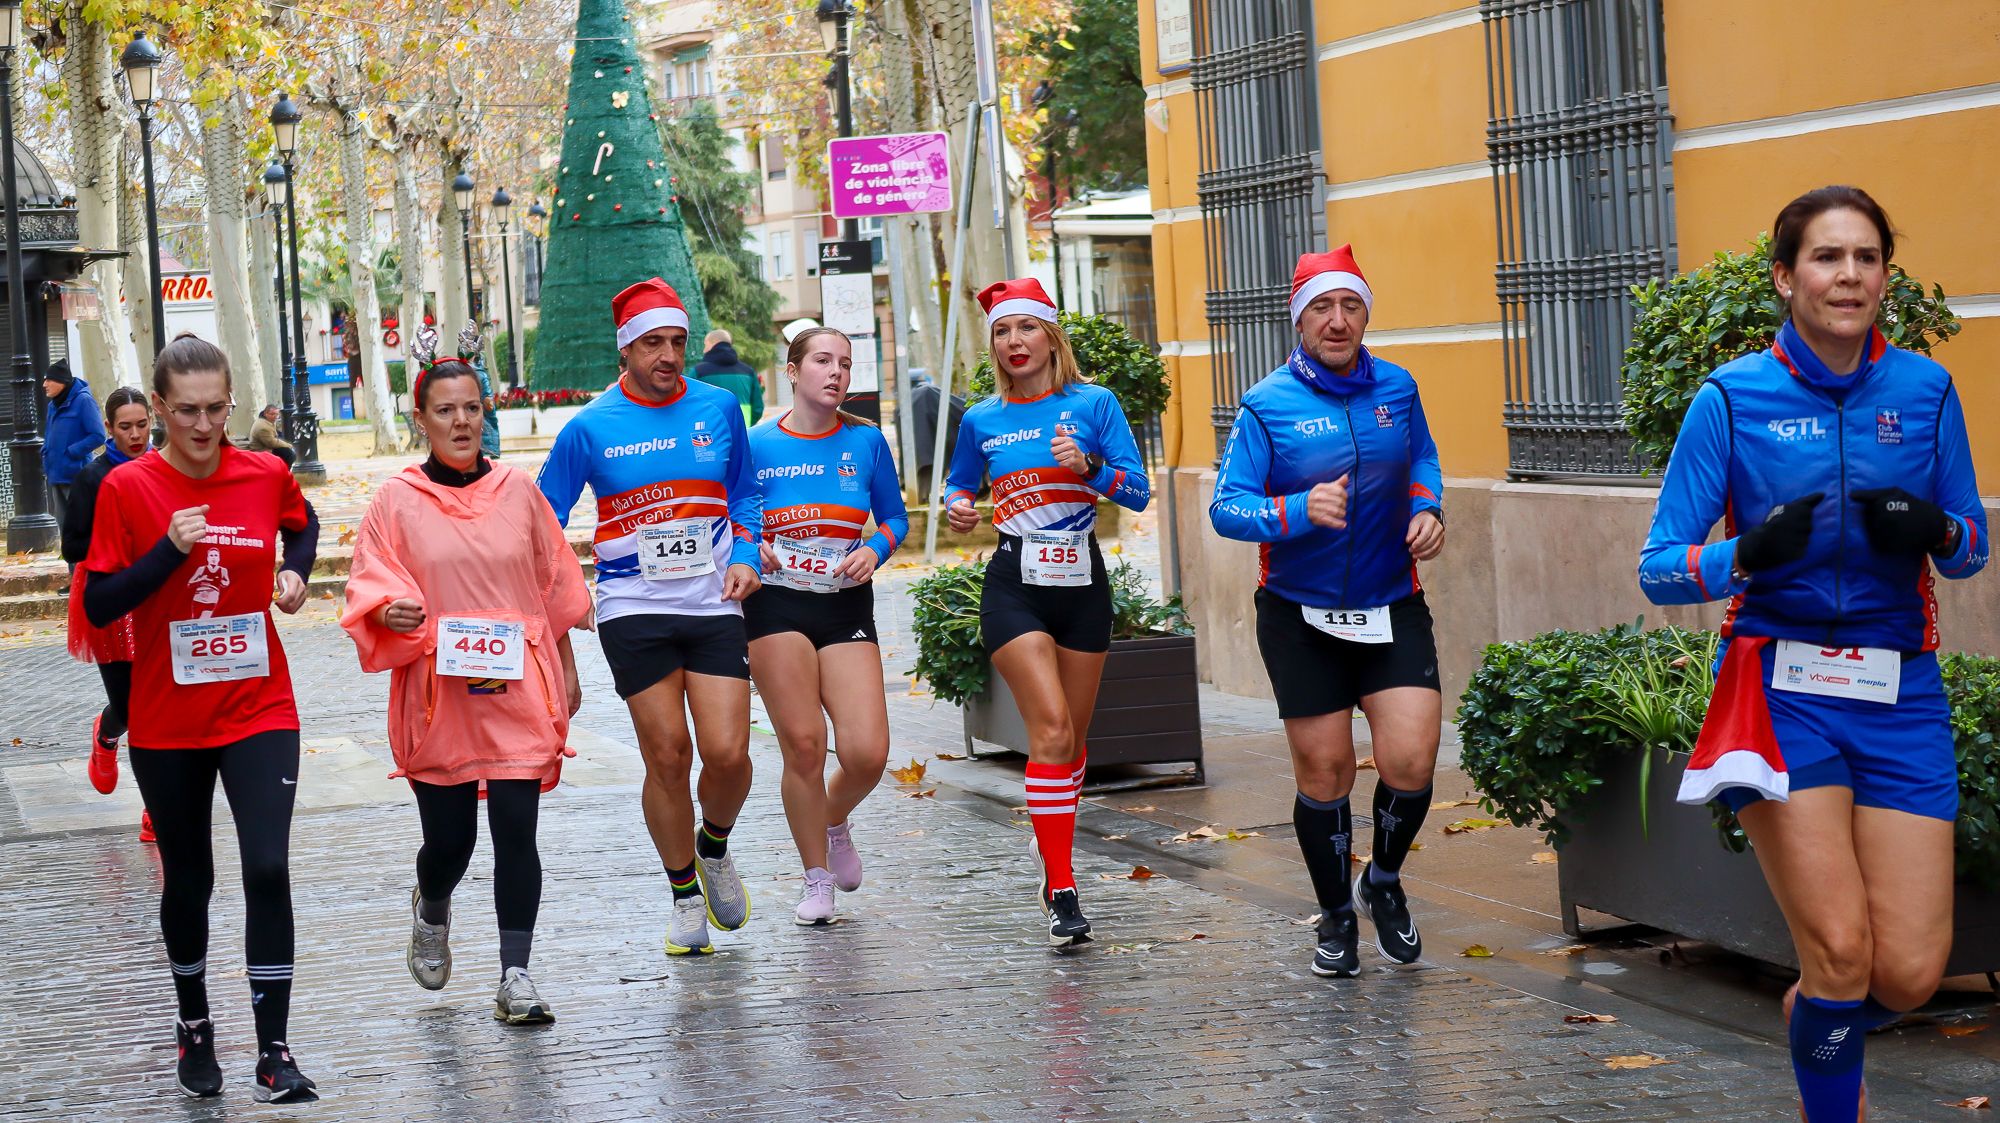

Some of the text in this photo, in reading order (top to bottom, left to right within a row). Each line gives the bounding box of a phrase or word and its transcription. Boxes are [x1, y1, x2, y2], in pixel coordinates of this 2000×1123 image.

[851, 160, 925, 174] Zona libre
[845, 174, 933, 190] de violencia
[853, 190, 927, 206] de género
[604, 438, 677, 459] enerplus
[982, 428, 1041, 452] enerplus
[757, 463, 825, 480] enerplus
[612, 484, 674, 513] Maratón
[619, 507, 673, 534] Lucena
[219, 536, 230, 546] de
[232, 536, 264, 548] Lucena
[656, 539, 697, 558] 143
[786, 554, 827, 575] 142
[1039, 547, 1078, 564] 135
[1324, 612, 1368, 626] 113
[191, 634, 248, 657] 265
[454, 637, 506, 656] 440
[1857, 678, 1887, 687] enerplus
